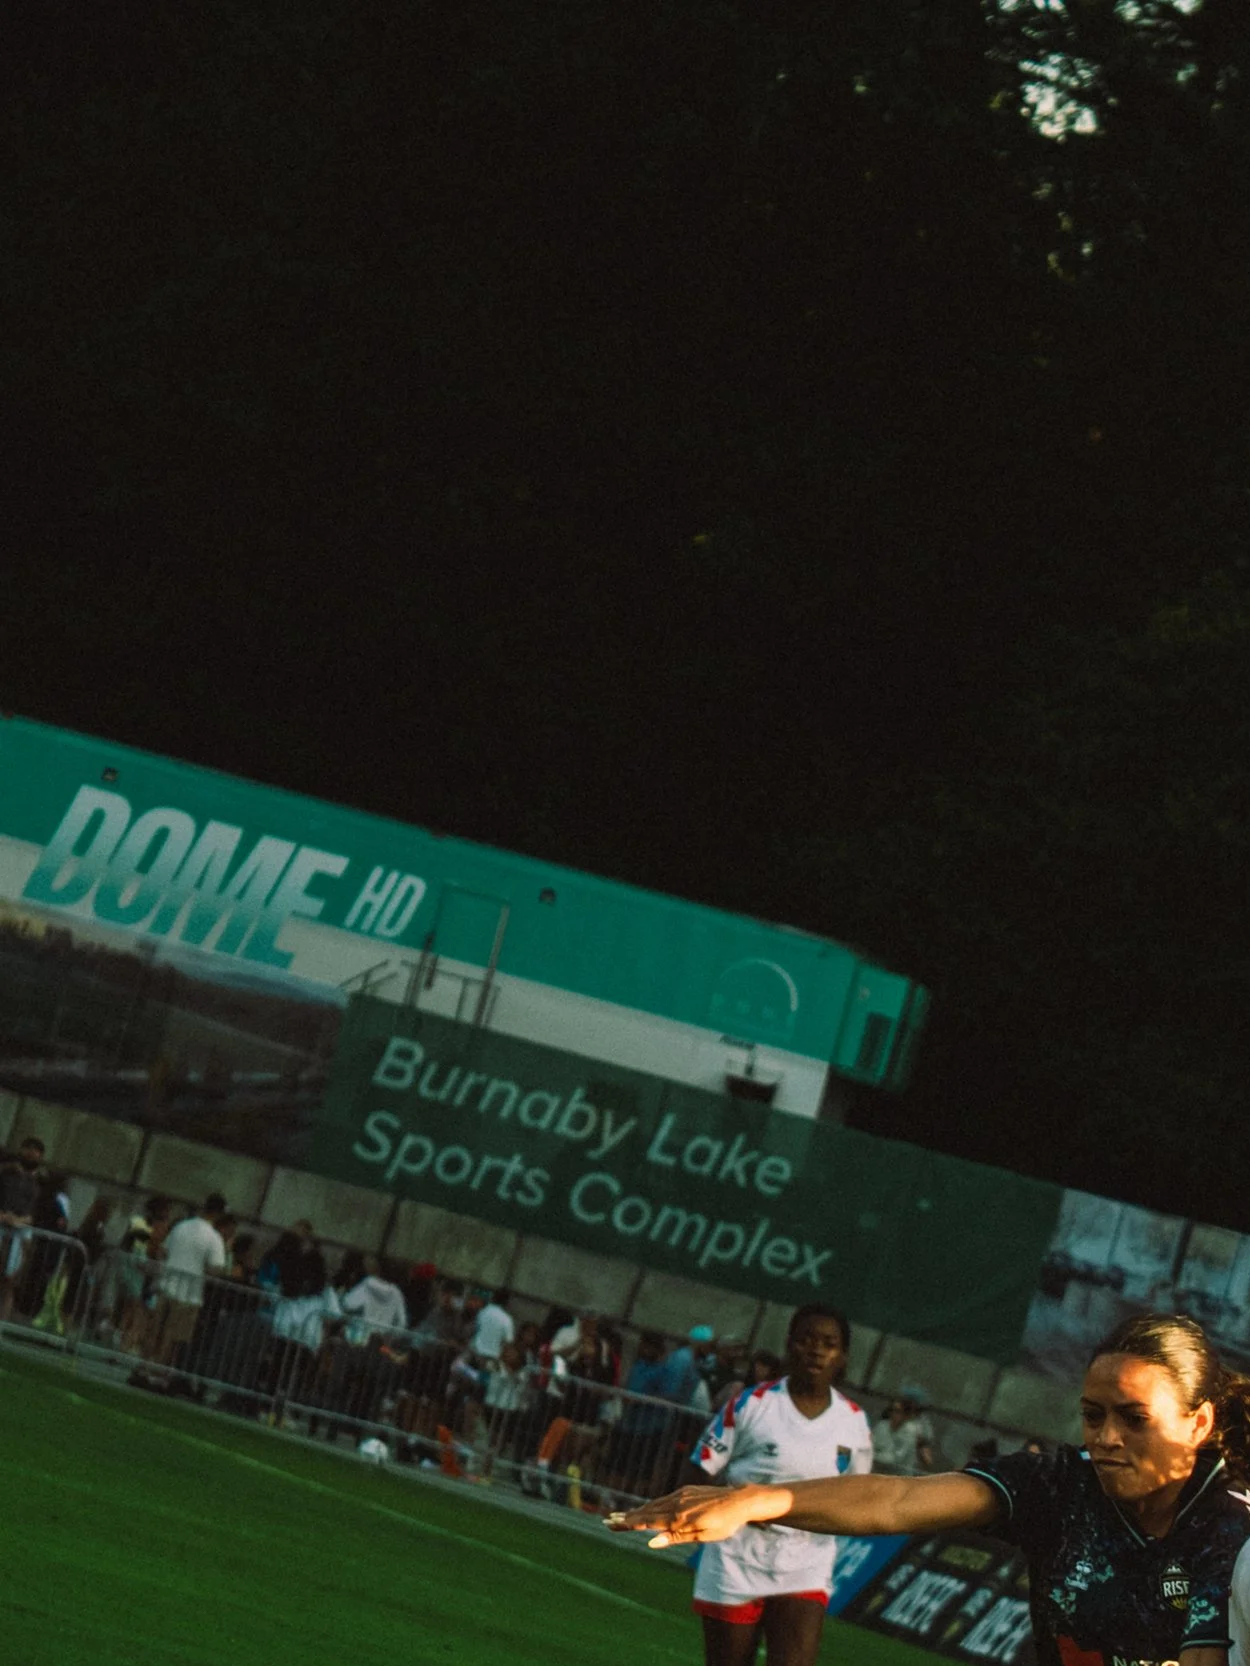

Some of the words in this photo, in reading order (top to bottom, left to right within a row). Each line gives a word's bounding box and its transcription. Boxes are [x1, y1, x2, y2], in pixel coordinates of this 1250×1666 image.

[21, 784, 350, 970] DOME
[344, 864, 427, 938] HD
[352, 1110, 550, 1208] Sports
[569, 1172, 833, 1287] Complex
[372, 1036, 638, 1160] Burnaby
[646, 1112, 793, 1196] Lake
